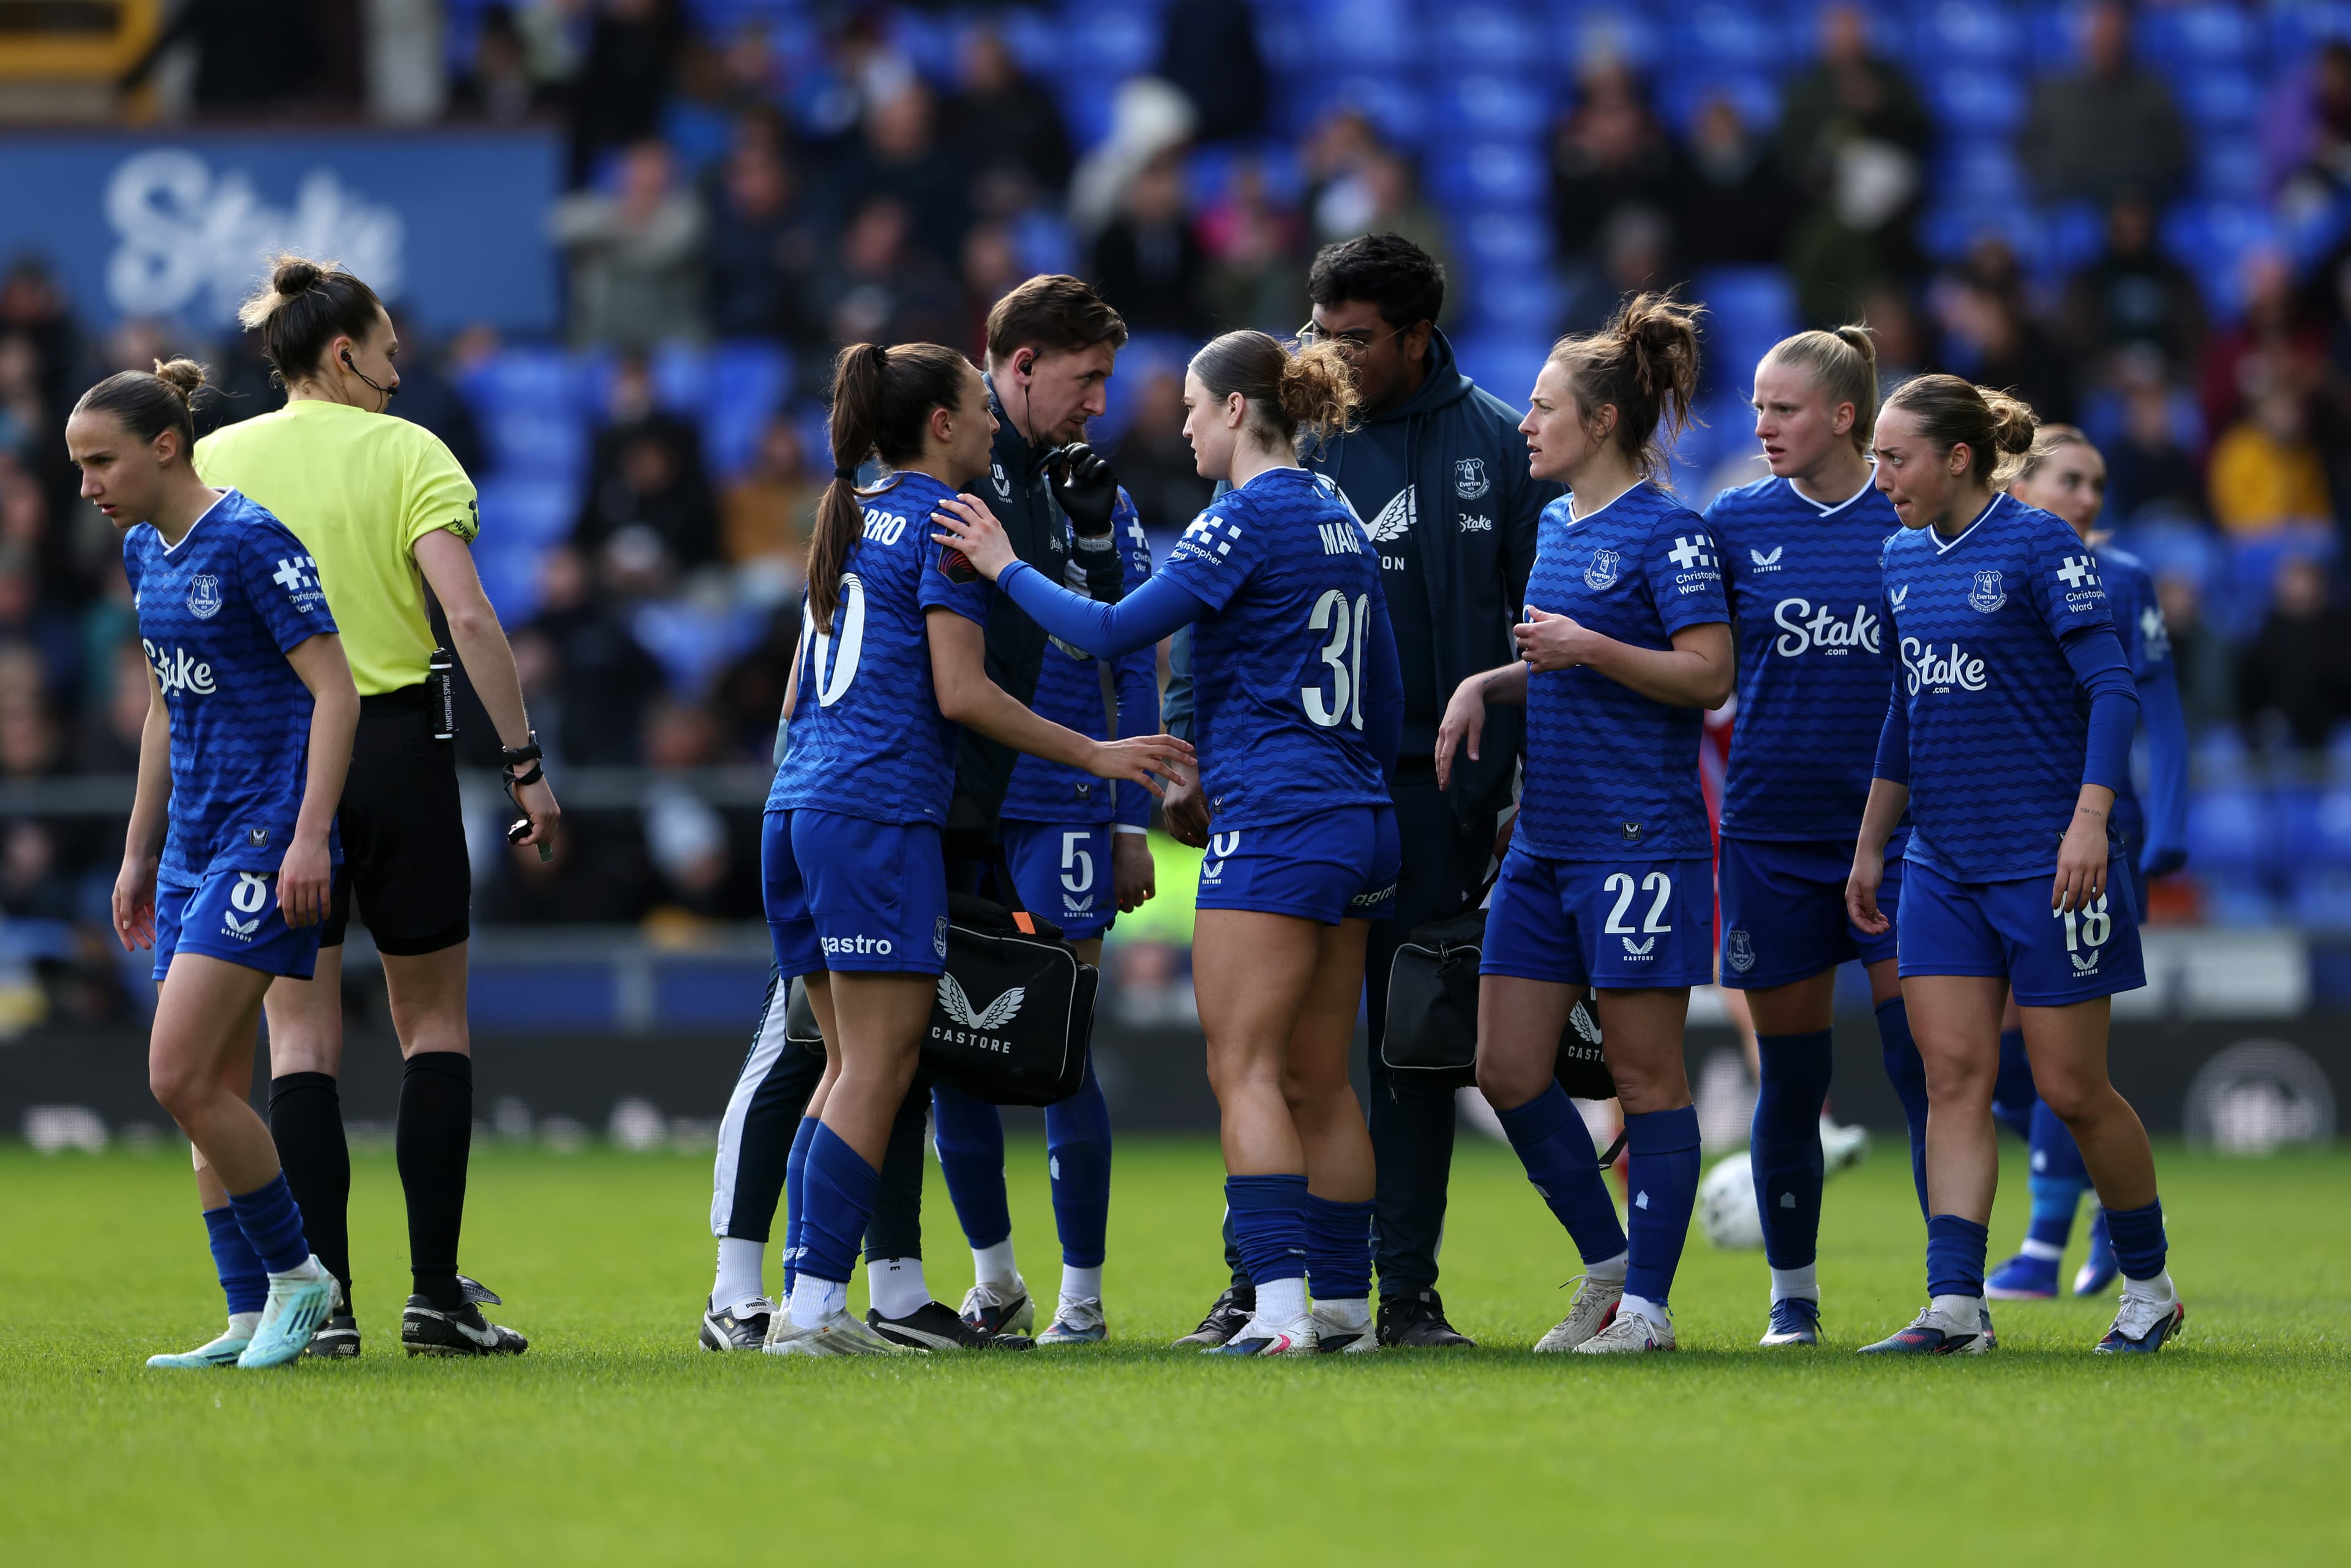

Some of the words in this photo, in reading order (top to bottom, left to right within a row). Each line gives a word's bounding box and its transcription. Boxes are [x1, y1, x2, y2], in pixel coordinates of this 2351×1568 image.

[992, 463, 1005, 480] LR
[860, 506, 907, 546] RRO
[1459, 513, 1492, 533] Stake
[1378, 555, 1405, 571] ON
[1753, 565, 1782, 574] CASTORE
[1591, 570, 1610, 580] Everton
[1678, 581, 1706, 595] Ward
[2068, 600, 2093, 613] Ward
[800, 571, 866, 708] 0
[1301, 588, 1370, 730] 30
[1824, 647, 1848, 656] .com
[1900, 636, 1987, 697] Stake
[442, 675, 451, 696] SPRAY
[444, 696, 453, 731] VANISHING
[1060, 831, 1093, 892] 5
[231, 871, 271, 913] 8
[1603, 871, 1671, 934] 22
[2053, 886, 2111, 951] 18
[220, 927, 252, 943] CASTORE
[820, 934, 892, 957] gastro
[2072, 968, 2098, 978] CASTORE
[932, 1026, 1011, 1054] CASTORE
[403, 1322, 421, 1331] NIKE
[337, 1344, 356, 1354] NIKE
